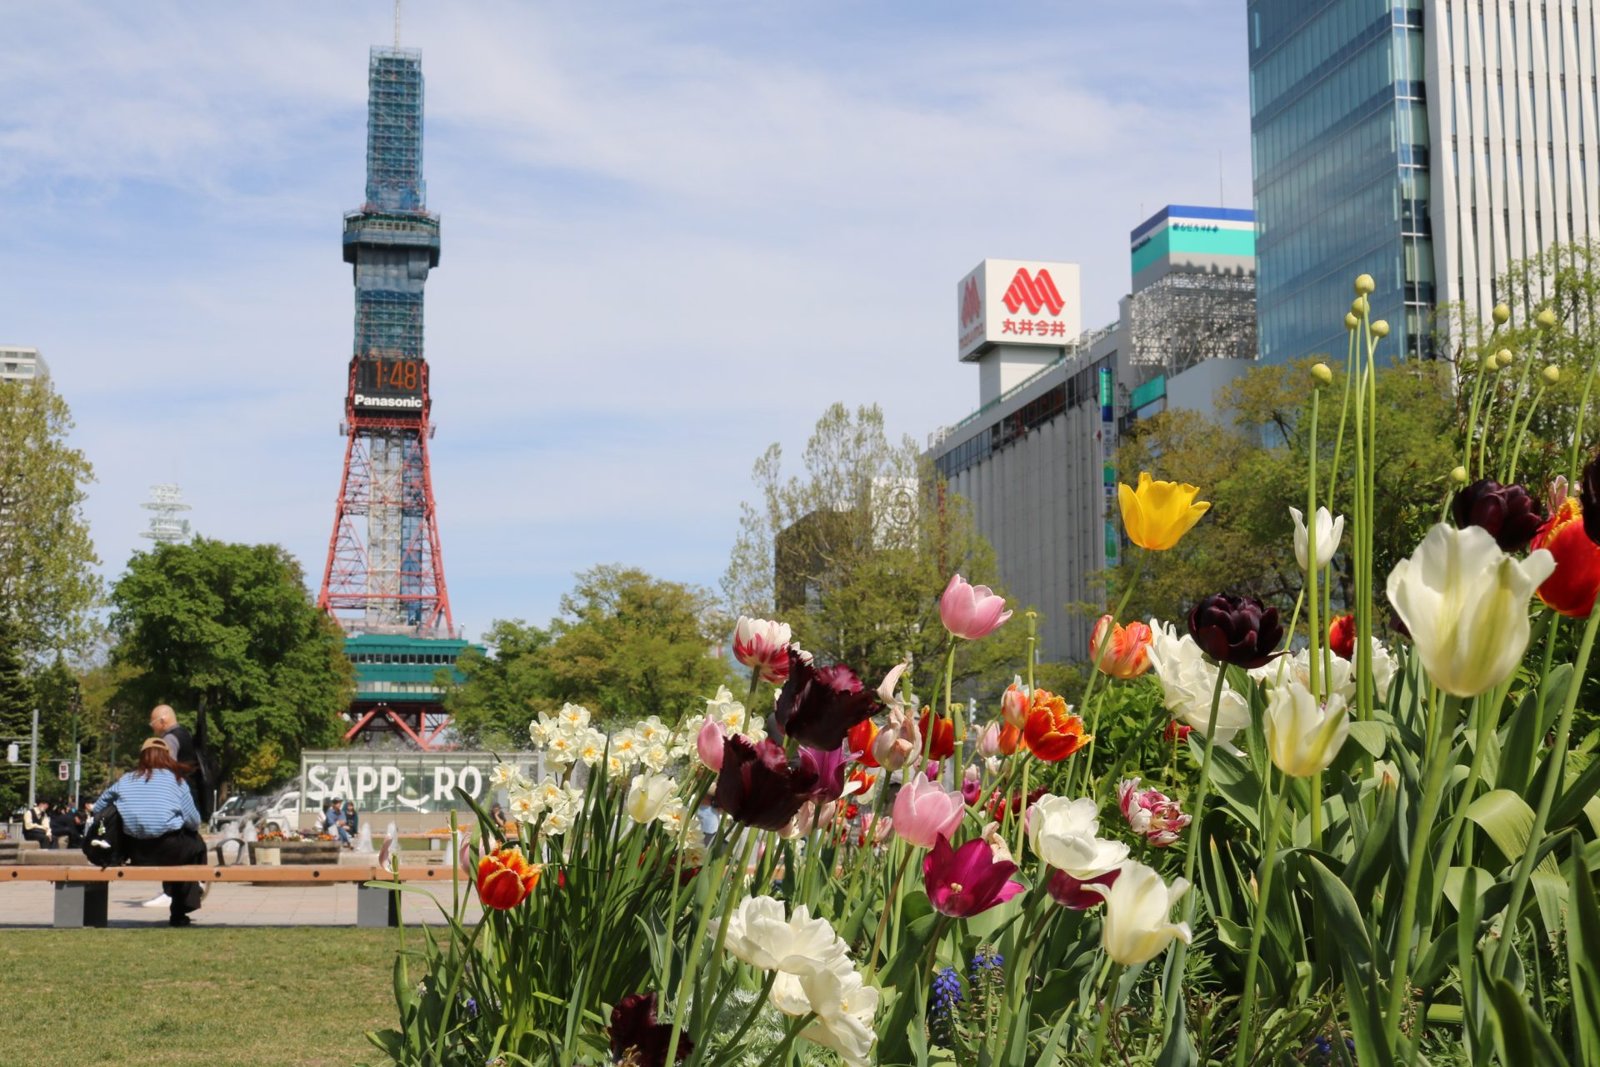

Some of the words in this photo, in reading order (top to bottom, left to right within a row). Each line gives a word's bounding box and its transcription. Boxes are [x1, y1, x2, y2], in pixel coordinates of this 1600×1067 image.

[1001, 318, 1066, 337] 丸井今井
[376, 361, 417, 390] 1:48
[354, 394, 422, 407] Panasonic
